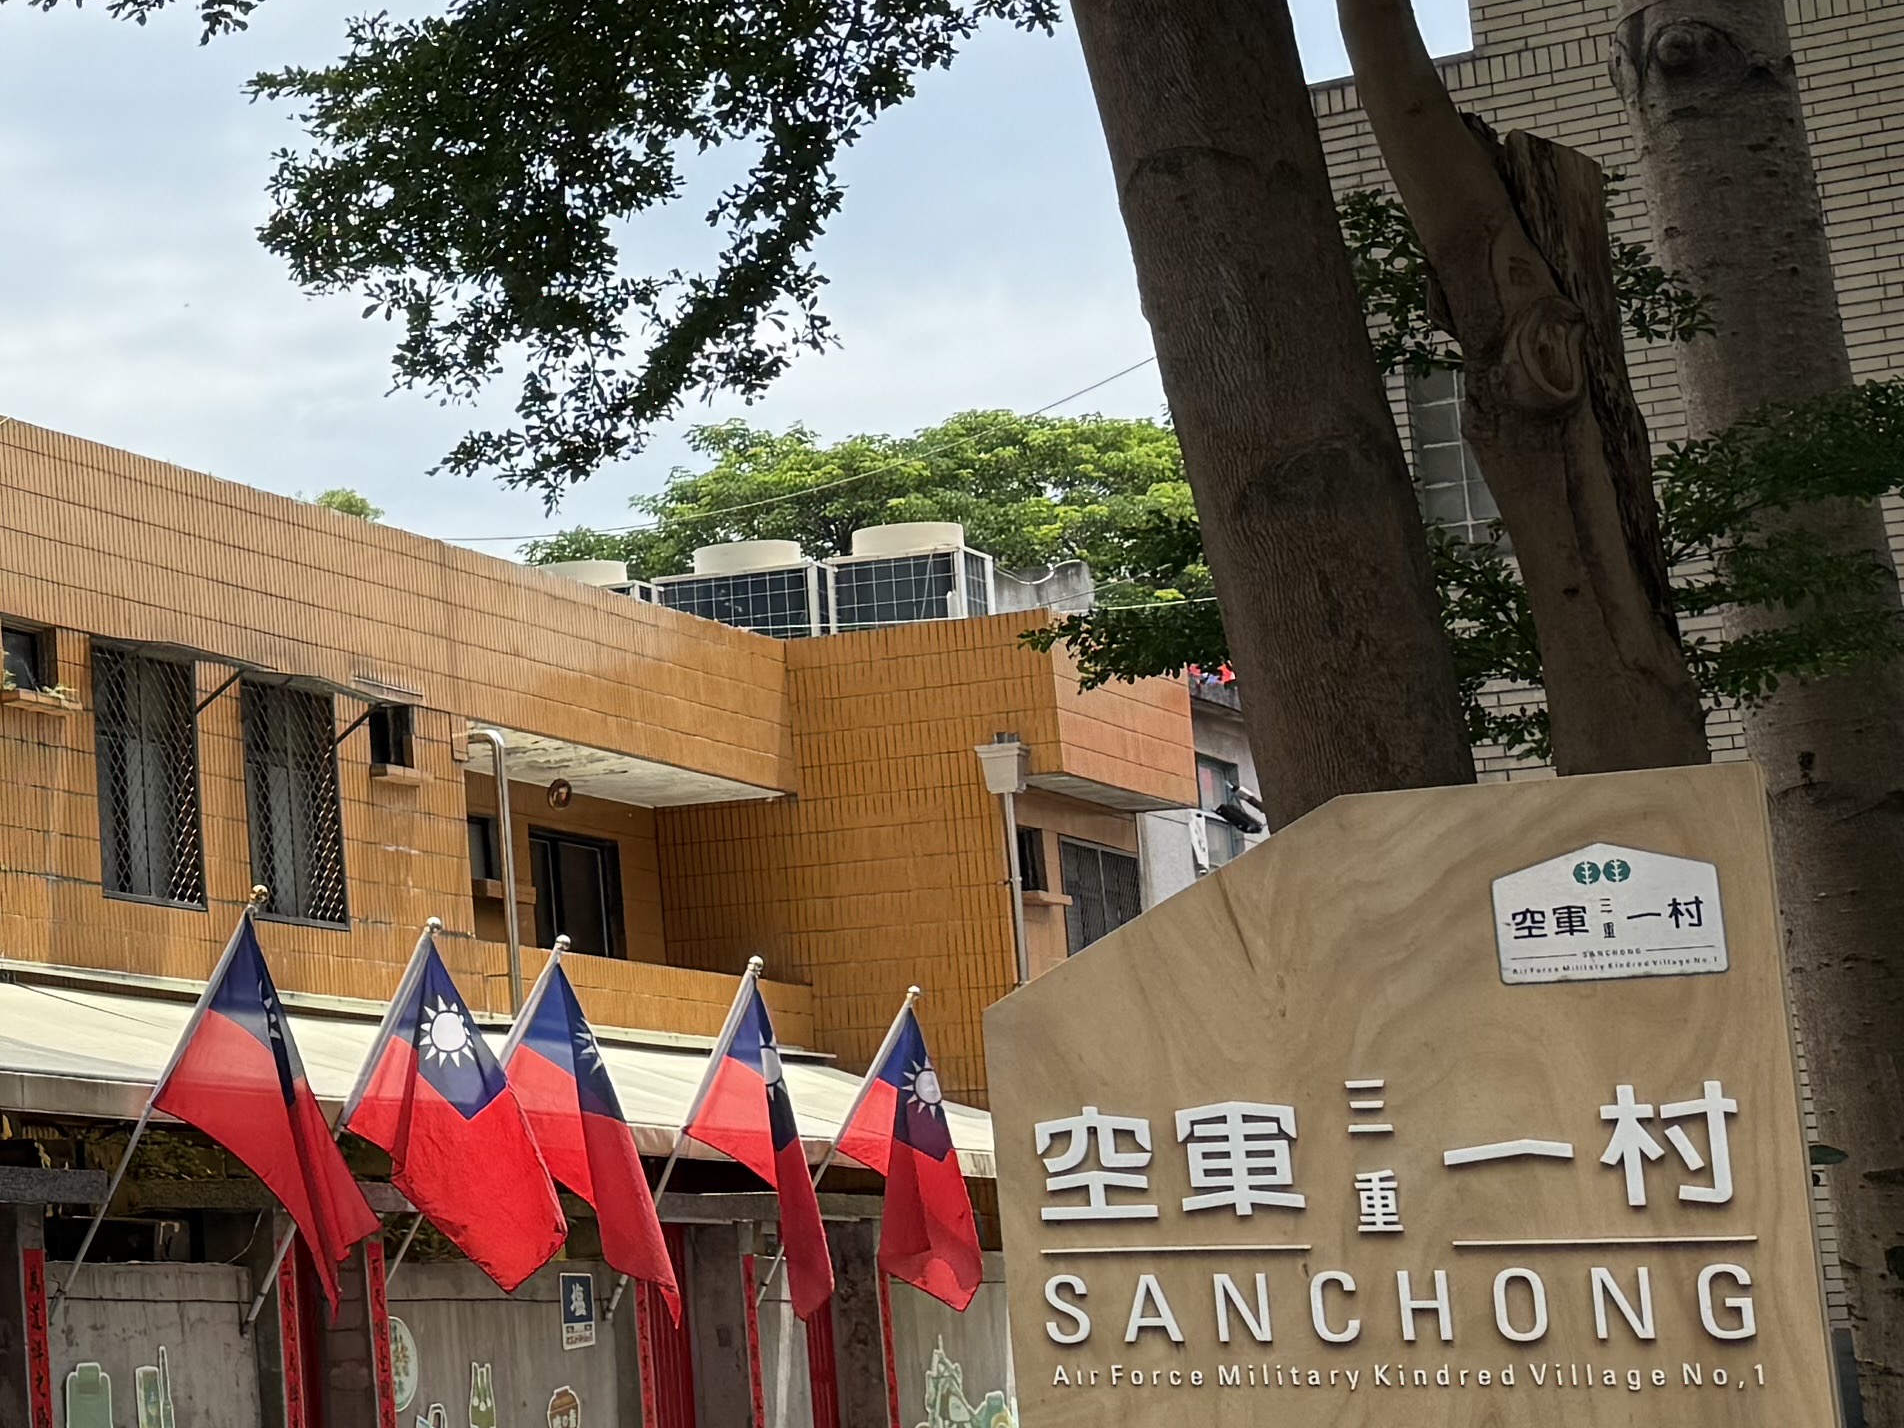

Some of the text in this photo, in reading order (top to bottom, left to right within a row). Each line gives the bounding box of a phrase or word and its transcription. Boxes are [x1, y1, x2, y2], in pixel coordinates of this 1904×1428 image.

[1512, 896, 1703, 939] 空軍三重一村
[1034, 1079, 1738, 1233] 空軍三重一村
[1043, 1263, 1759, 1345] SANCHONG
[1053, 1365, 1098, 1386] Air
[1111, 1364, 1203, 1387] Force
[1218, 1364, 1359, 1390] Military
[1374, 1362, 1514, 1387] Kindred
[1529, 1363, 1666, 1391] Village
